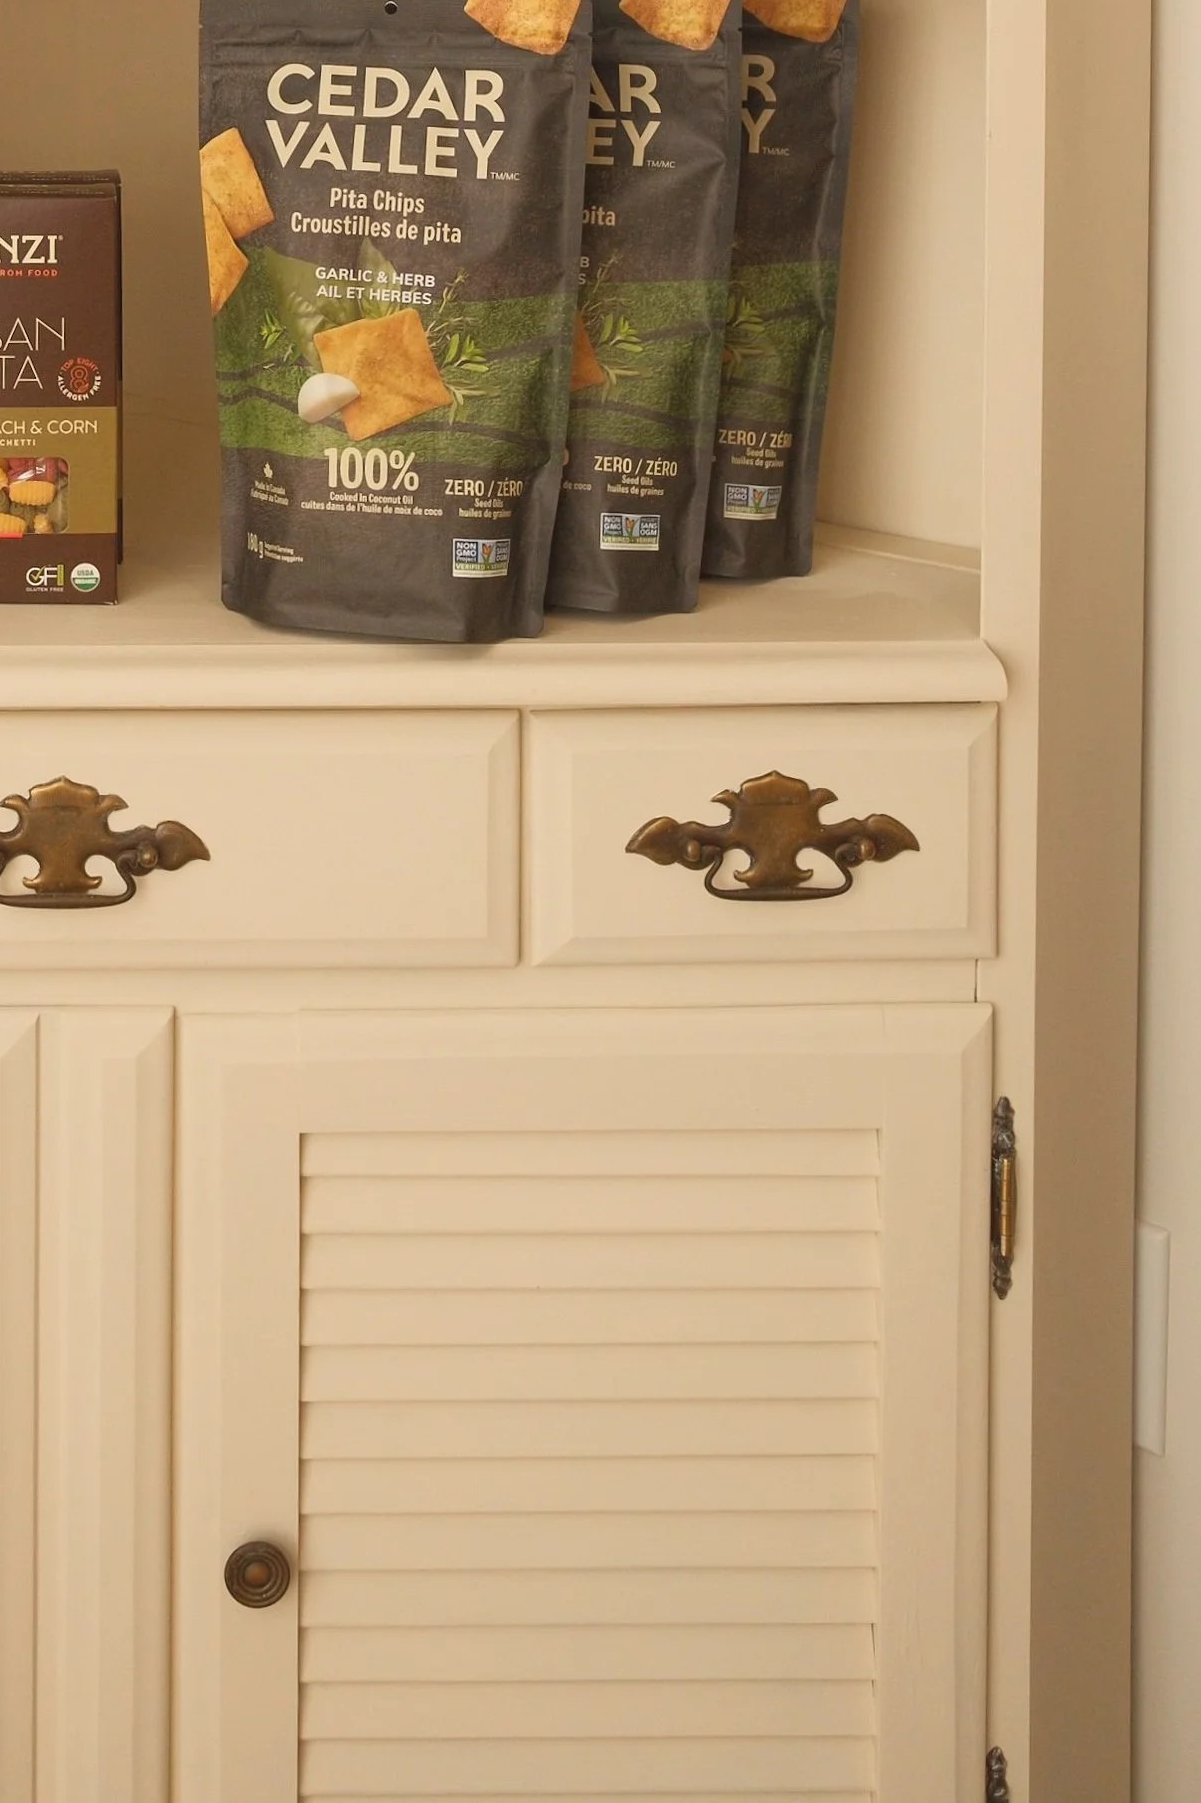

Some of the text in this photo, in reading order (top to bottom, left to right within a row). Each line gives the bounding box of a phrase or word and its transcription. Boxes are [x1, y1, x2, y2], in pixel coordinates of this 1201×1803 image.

[267, 63, 506, 123] CEDAR
[265, 120, 504, 180] VALLEY
[330, 187, 425, 214] Pita Chips
[291, 212, 462, 246] Croustilles de pita
[28, 269, 58, 277] FOOD
[315, 267, 436, 287] GARLIC & HERB
[316, 285, 432, 305] AIL ET HERBES
[30, 420, 42, 434] &
[46, 419, 98, 434] CORN
[718, 429, 756, 446] ZERO
[324, 447, 419, 492] 100%
[594, 456, 677, 476] ZERO ZÉRO
[444, 476, 523, 497] ZERO ZÉRO
[622, 475, 638, 485] Seed
[330, 491, 400, 505] Cooked Coconut
[607, 484, 664, 497] huiles de graines
[301, 500, 345, 512] cuites dans
